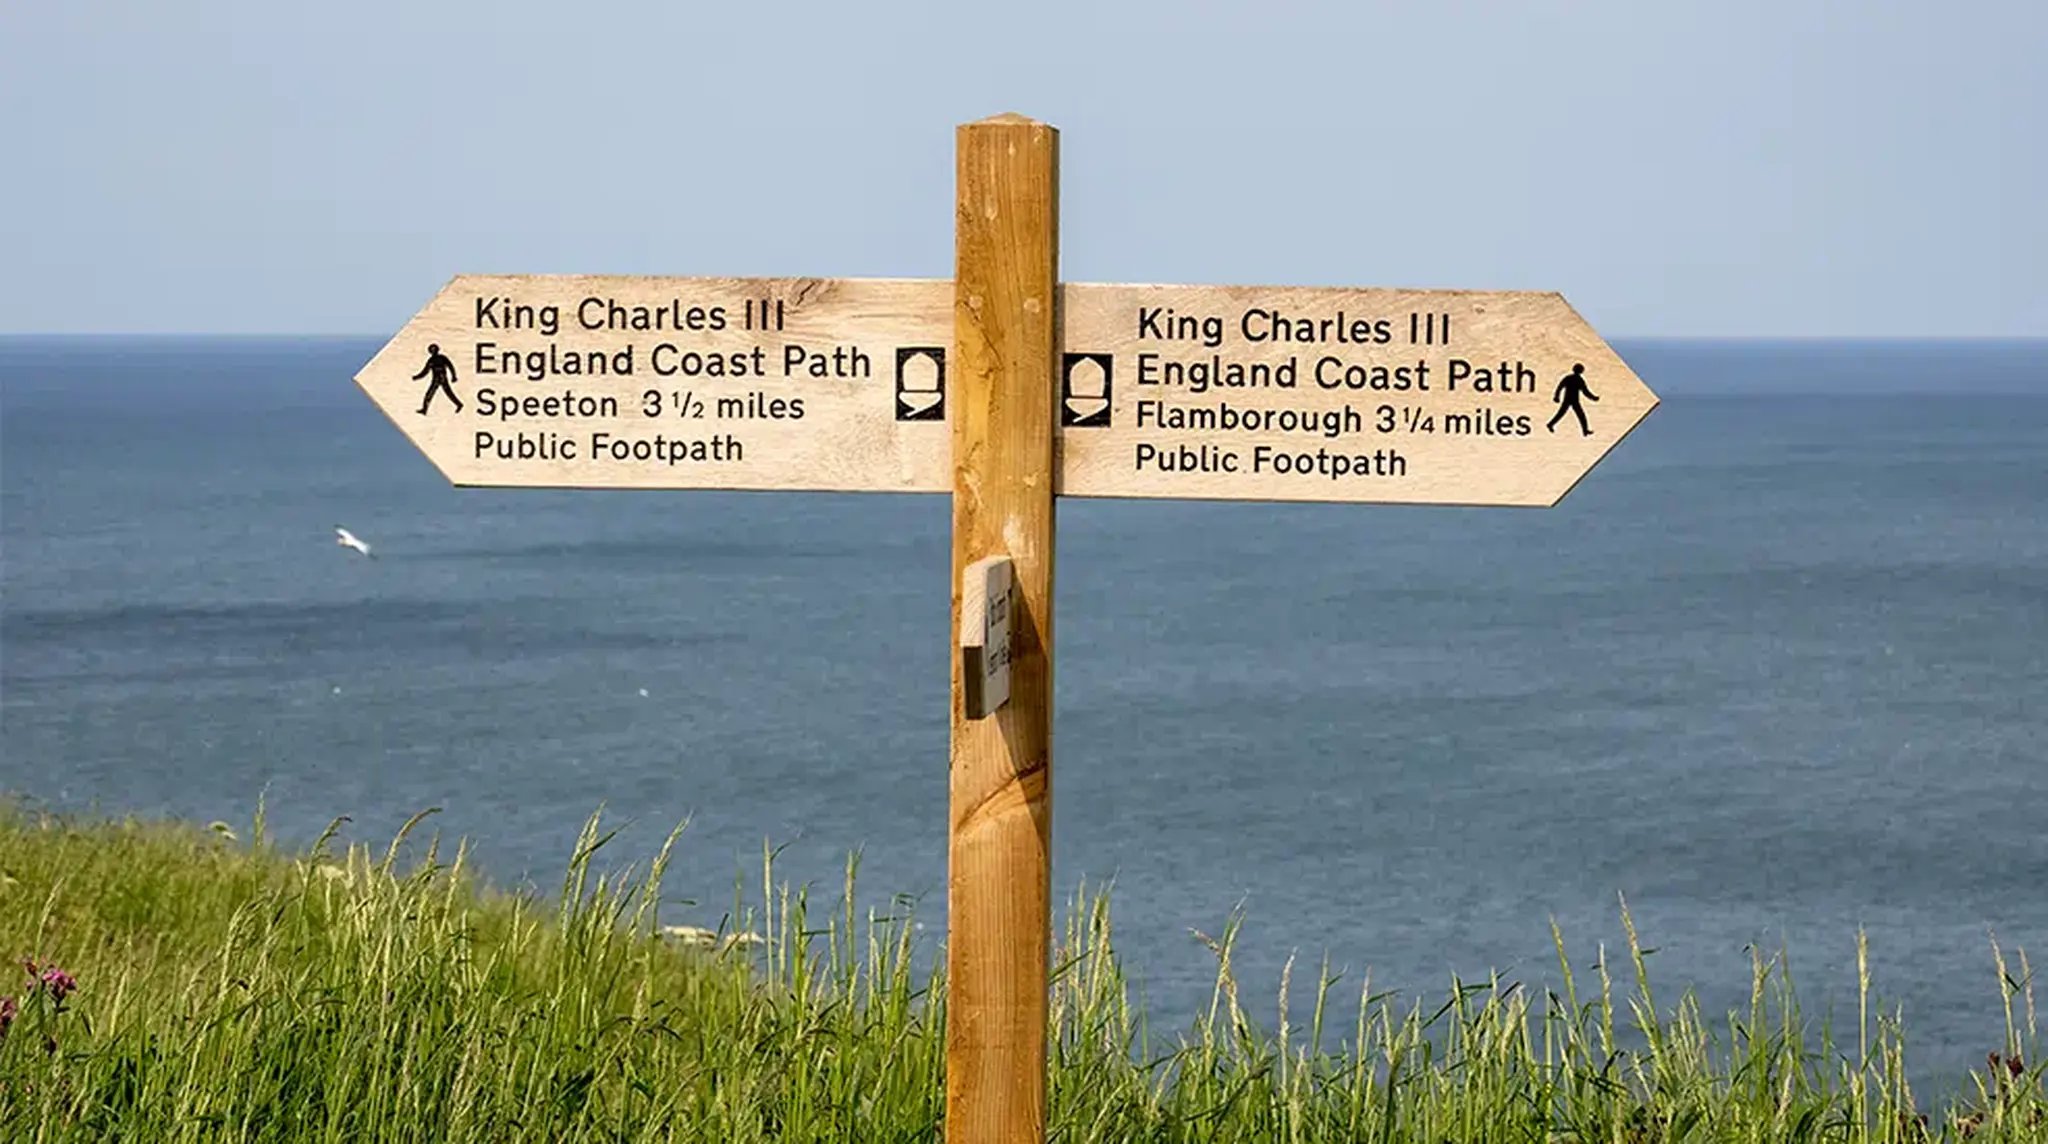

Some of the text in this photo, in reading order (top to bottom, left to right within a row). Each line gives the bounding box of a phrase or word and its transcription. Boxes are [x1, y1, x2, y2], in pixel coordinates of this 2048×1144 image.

[476, 296, 785, 336] King Charles III
[1139, 307, 1450, 348] King Charles III
[475, 342, 870, 381] England Coast Path
[1137, 353, 1536, 394] England Coast Path
[476, 388, 617, 422] Speeton
[643, 389, 662, 418] 3
[717, 391, 805, 420] miles
[1137, 400, 1362, 438] Flamborough
[1376, 404, 1396, 434] 3
[1444, 408, 1532, 437] miles
[475, 431, 743, 466] Public Footpath
[1136, 443, 1406, 481] Public Footpath
